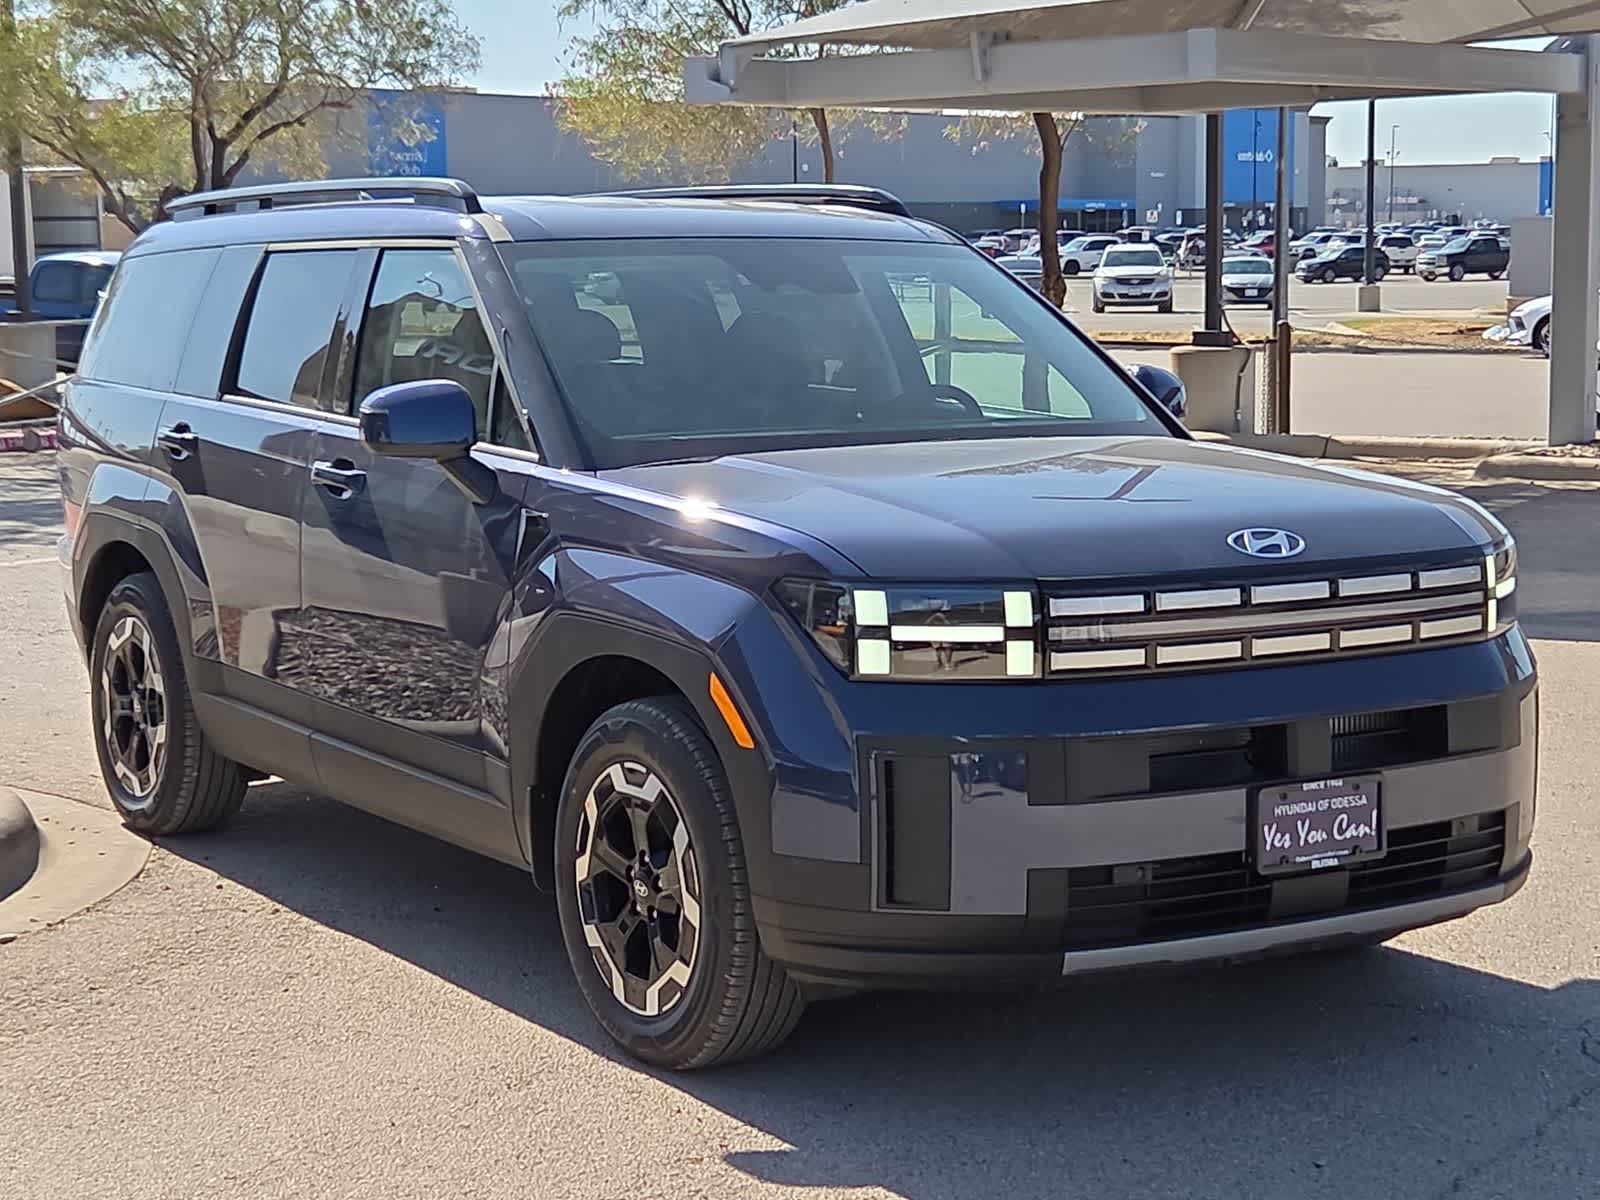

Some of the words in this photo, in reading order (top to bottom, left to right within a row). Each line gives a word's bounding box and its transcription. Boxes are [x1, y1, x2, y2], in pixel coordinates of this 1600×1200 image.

[1274, 800, 1316, 817] HYUNDAI
[1318, 799, 1329, 811] OF
[1331, 794, 1368, 809] ODESSA
[1263, 822, 1291, 852] Yes
[1297, 818, 1328, 847] You
[1333, 808, 1378, 840] Can!
